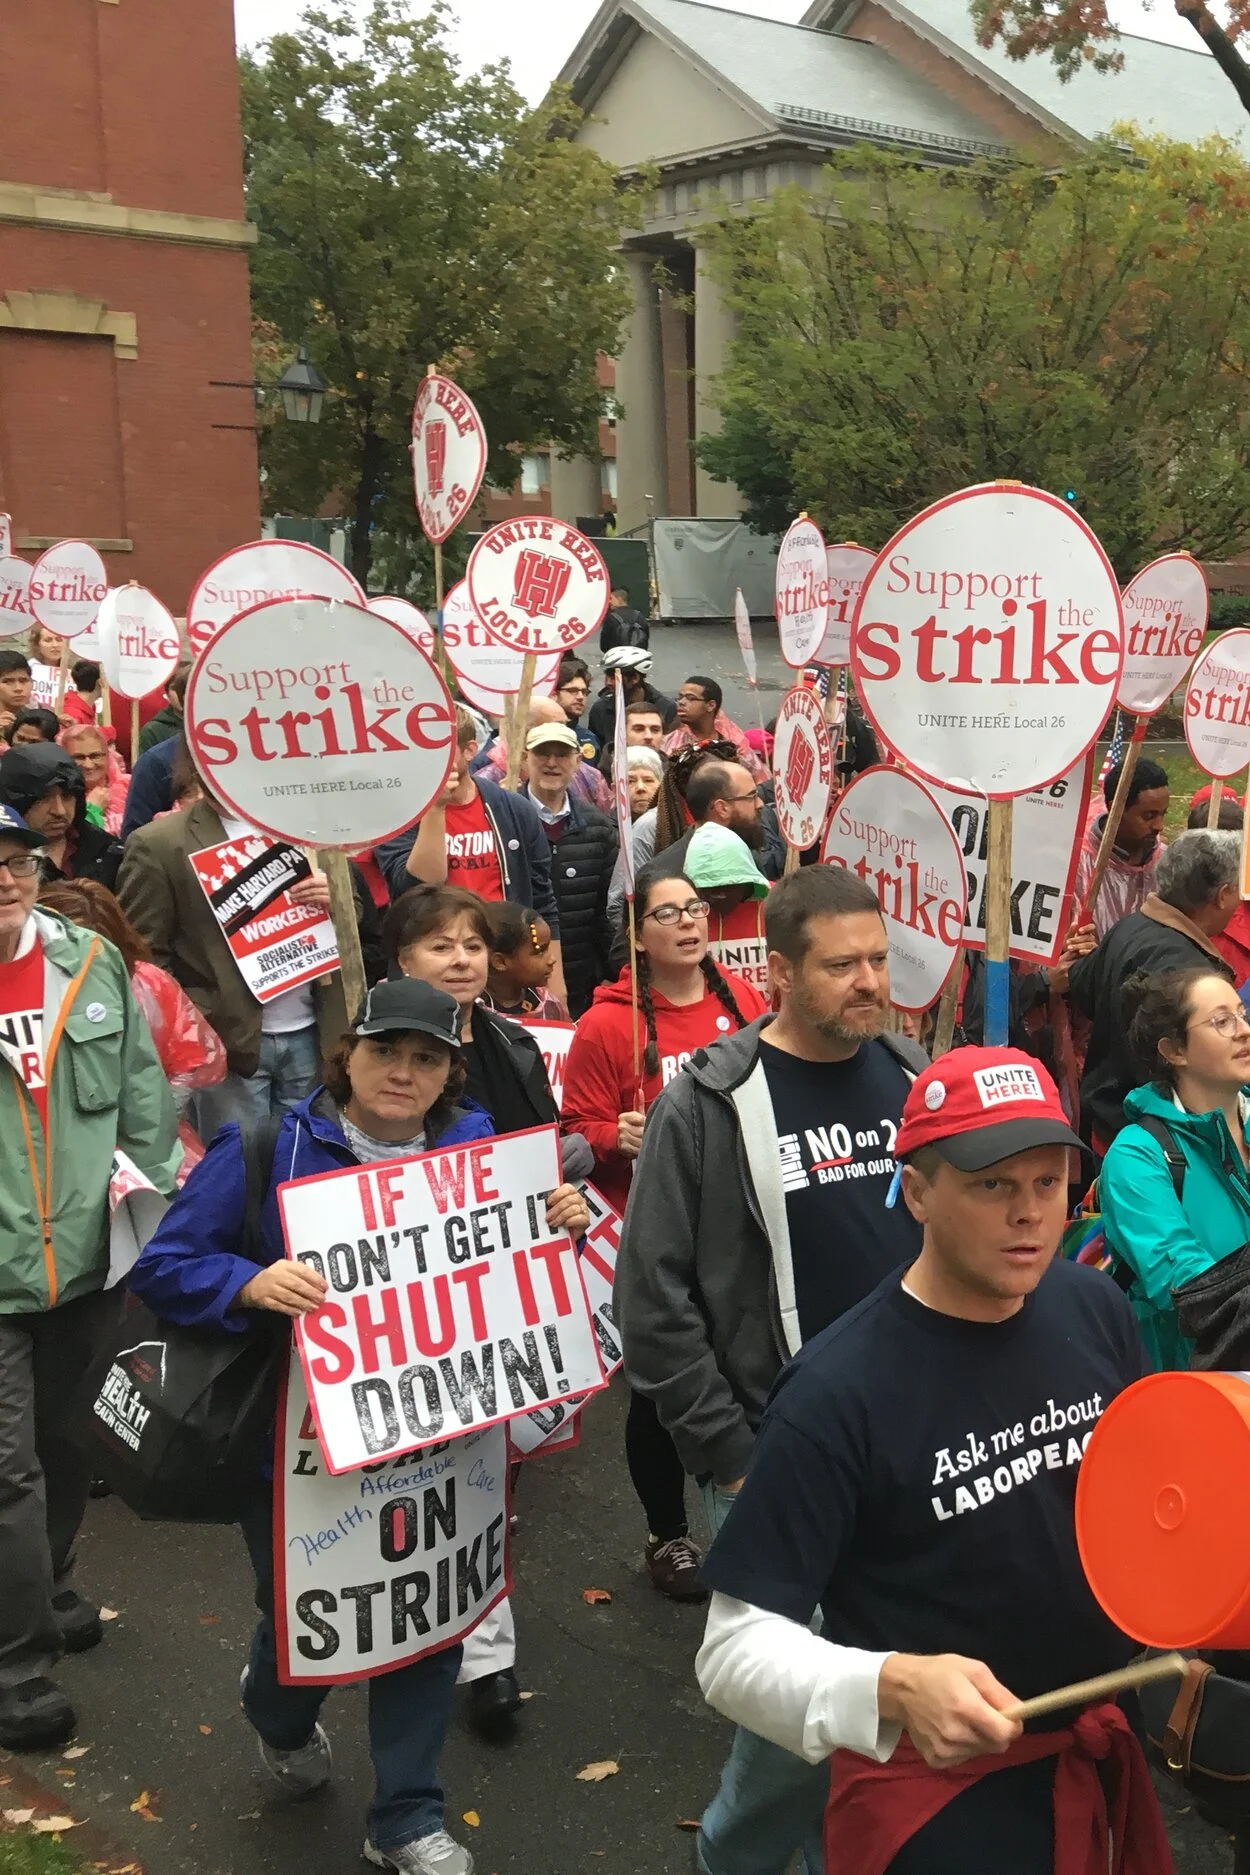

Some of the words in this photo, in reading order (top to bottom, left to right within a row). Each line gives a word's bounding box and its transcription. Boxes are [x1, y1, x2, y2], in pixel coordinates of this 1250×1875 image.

[435, 383, 476, 438] HERE
[446, 483, 467, 517] 26
[486, 521, 554, 554] UNITE
[559, 530, 604, 583] HERE
[29, 575, 107, 602] strike
[777, 570, 830, 617] strike
[887, 556, 1042, 610] Support
[1126, 590, 1184, 617] Support
[479, 597, 548, 648] LOCAL
[557, 616, 587, 644] 26
[1058, 599, 1094, 627] the
[1182, 612, 1196, 627] the
[119, 626, 179, 660] trike
[856, 598, 1121, 685] strike
[1128, 613, 1202, 657] trike
[206, 662, 352, 701] Support
[373, 680, 415, 704] the
[195, 683, 452, 765] strike
[784, 693, 814, 722] UNITE
[813, 717, 831, 785] HERE
[918, 714, 967, 728] UNITE
[972, 714, 1010, 728] HERE
[1014, 715, 1048, 728] Local
[1050, 716, 1065, 728] 26
[264, 784, 307, 798] UNITE
[310, 782, 346, 794] HERE
[350, 779, 383, 792] Local
[386, 777, 402, 789] 26
[774, 769, 795, 839] LOCAL
[800, 816, 814, 843] 26
[1026, 796, 1044, 806] UNITE
[444, 830, 493, 857] OSTON
[839, 807, 917, 861] Support
[215, 891, 246, 924] MAKE
[237, 858, 287, 900] HARVARD
[924, 866, 948, 893] the
[256, 938, 303, 964] SOCIALIST
[260, 942, 319, 974] ALTERNATIVE
[251, 966, 290, 990] SUPPORTS
[290, 960, 305, 973] THE
[982, 1070, 1035, 1087] UNITE
[986, 1084, 1039, 1101] HERE!
[805, 1123, 852, 1163] NO
[855, 1130, 880, 1148] on
[358, 1168, 405, 1231] IF
[423, 1145, 499, 1215] WE
[818, 1167, 844, 1184] BAD
[844, 1162, 867, 1179] FOR
[868, 1158, 894, 1175] OUR
[297, 1224, 429, 1293] DON'T
[444, 1201, 512, 1264] GET
[304, 1261, 490, 1385] SHUT
[513, 1238, 572, 1326] IT
[101, 1371, 151, 1432] HEALTH
[352, 1324, 569, 1456] DOWN!
[114, 1420, 140, 1452] CENTER
[932, 1432, 989, 1485] Ask
[991, 1422, 1025, 1455] me
[1030, 1392, 1103, 1436] about
[361, 1455, 457, 1497] Affordable
[467, 1458, 495, 1491] Care
[289, 1504, 372, 1566] Health
[380, 1476, 457, 1562] ON
[296, 1512, 503, 1660] STRIKE
